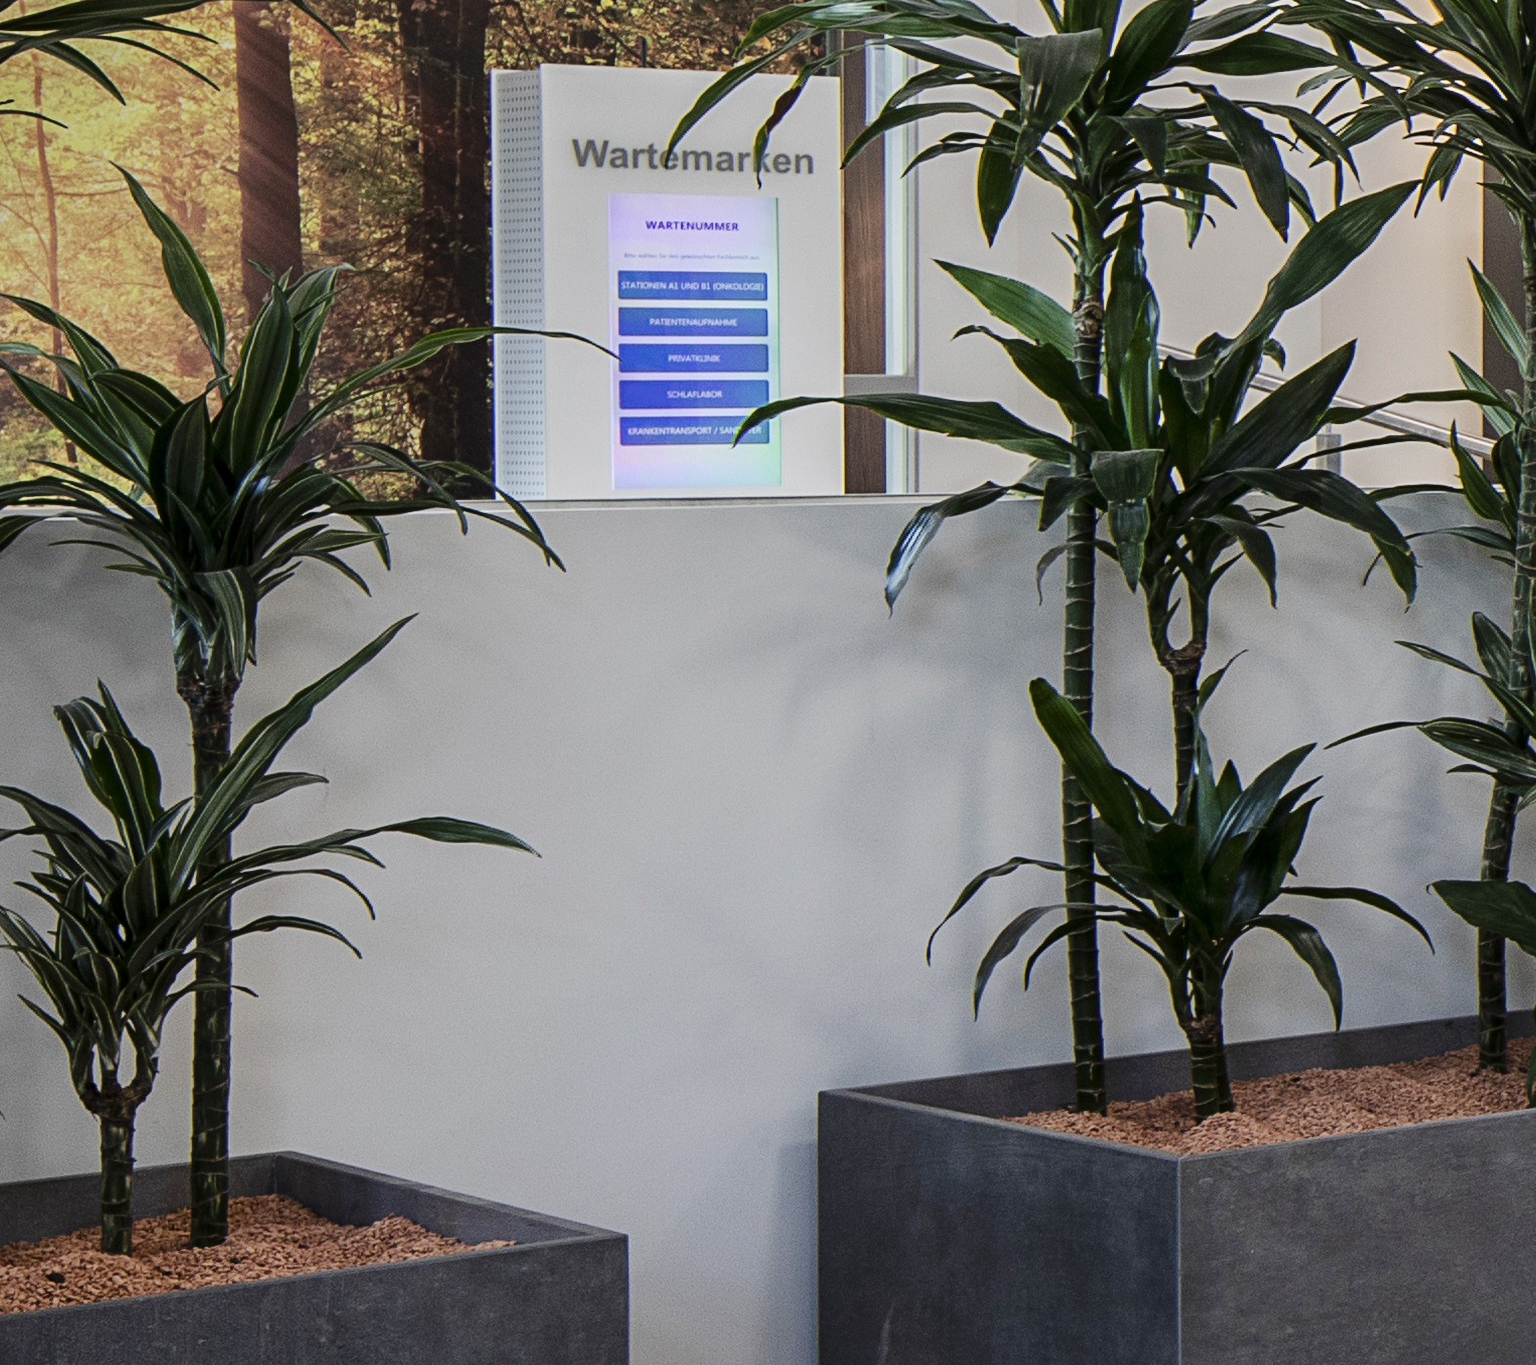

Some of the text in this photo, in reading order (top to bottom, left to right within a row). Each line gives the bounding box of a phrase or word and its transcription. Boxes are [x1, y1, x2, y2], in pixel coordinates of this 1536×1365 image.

[572, 139, 814, 174] Wartemarken
[645, 221, 739, 231] WARTENUMMER
[621, 281, 668, 290] STATIONEN
[681, 282, 700, 290] UND
[649, 318, 738, 326] PATIENTENAUFNAHME
[667, 391, 722, 399] SCHLAFLABOR
[628, 427, 712, 435] KRANKENTRANSPORT
